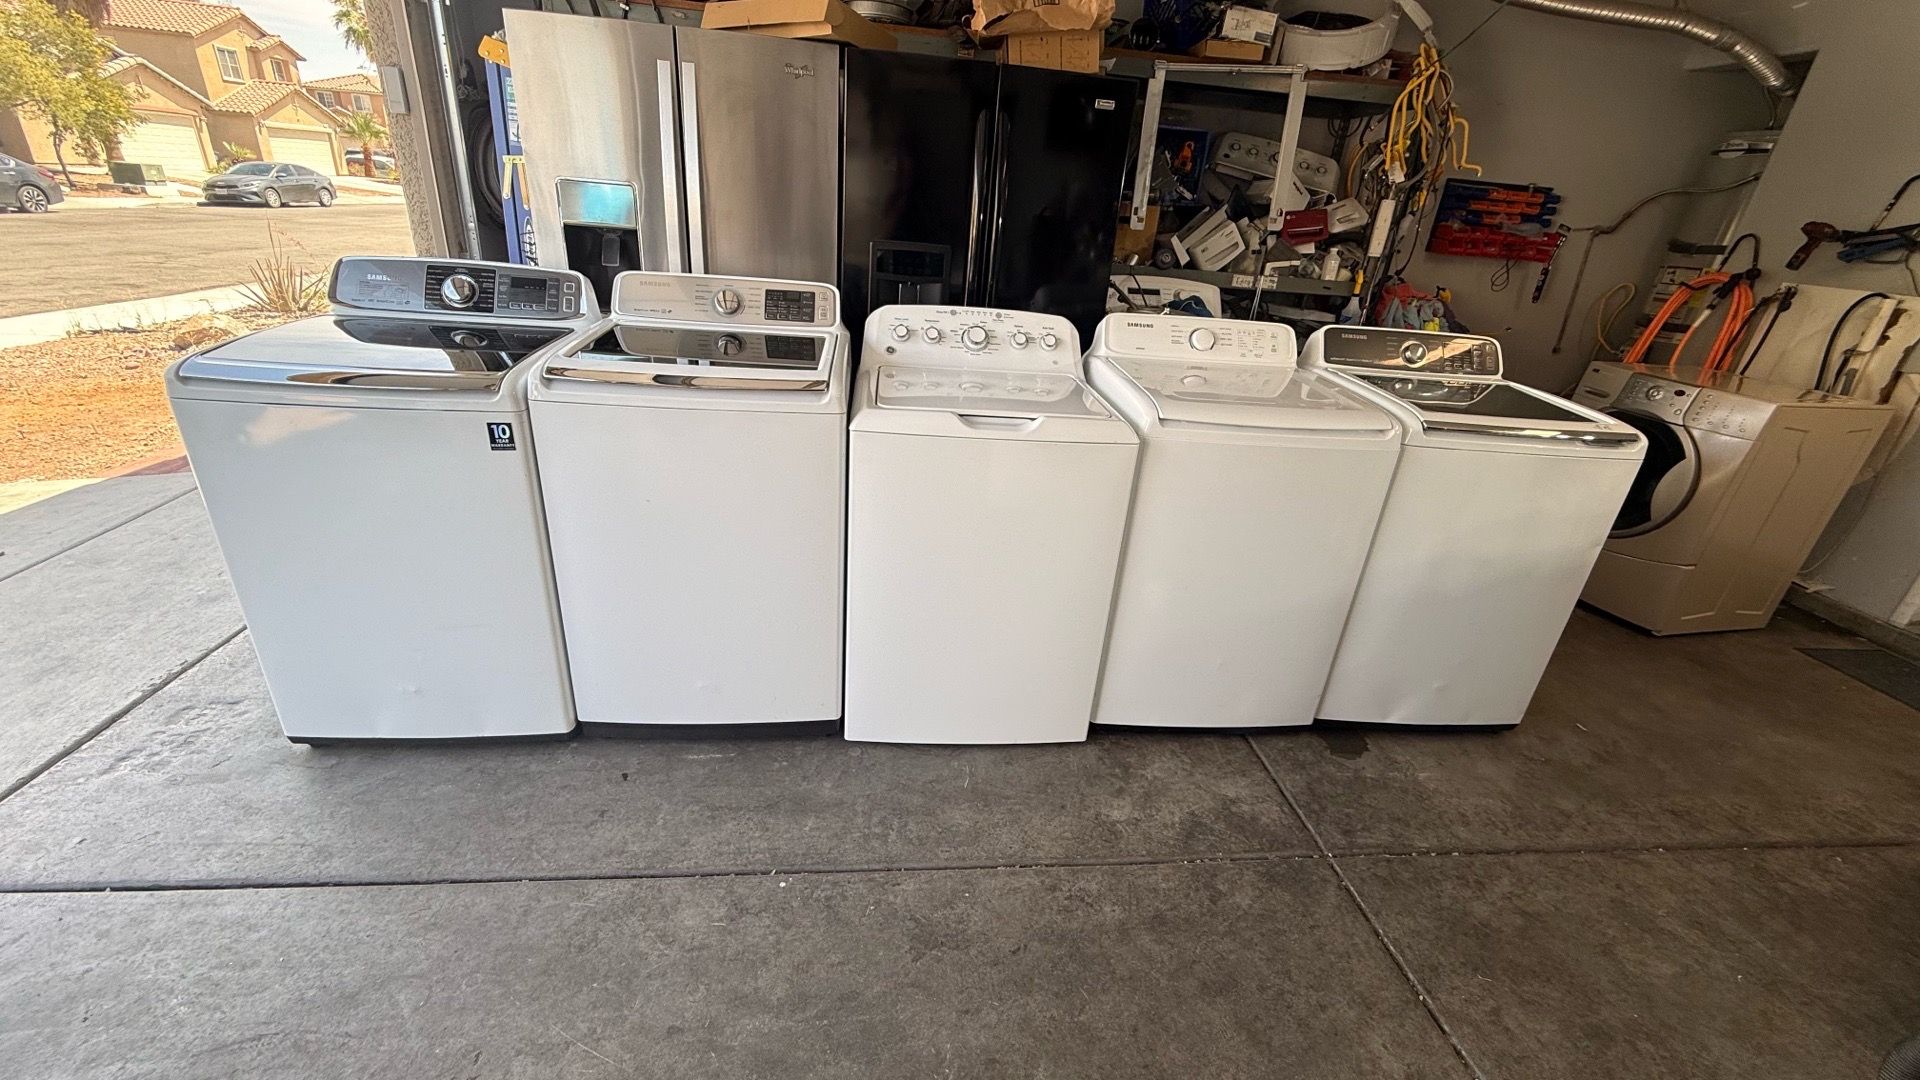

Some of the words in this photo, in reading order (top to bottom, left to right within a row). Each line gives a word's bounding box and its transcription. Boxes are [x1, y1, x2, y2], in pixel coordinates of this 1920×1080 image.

[367, 273, 401, 281] SAMS
[639, 280, 671, 288] SAMSUNG
[1127, 321, 1154, 329] SAMSUNG
[490, 424, 511, 439] 10
